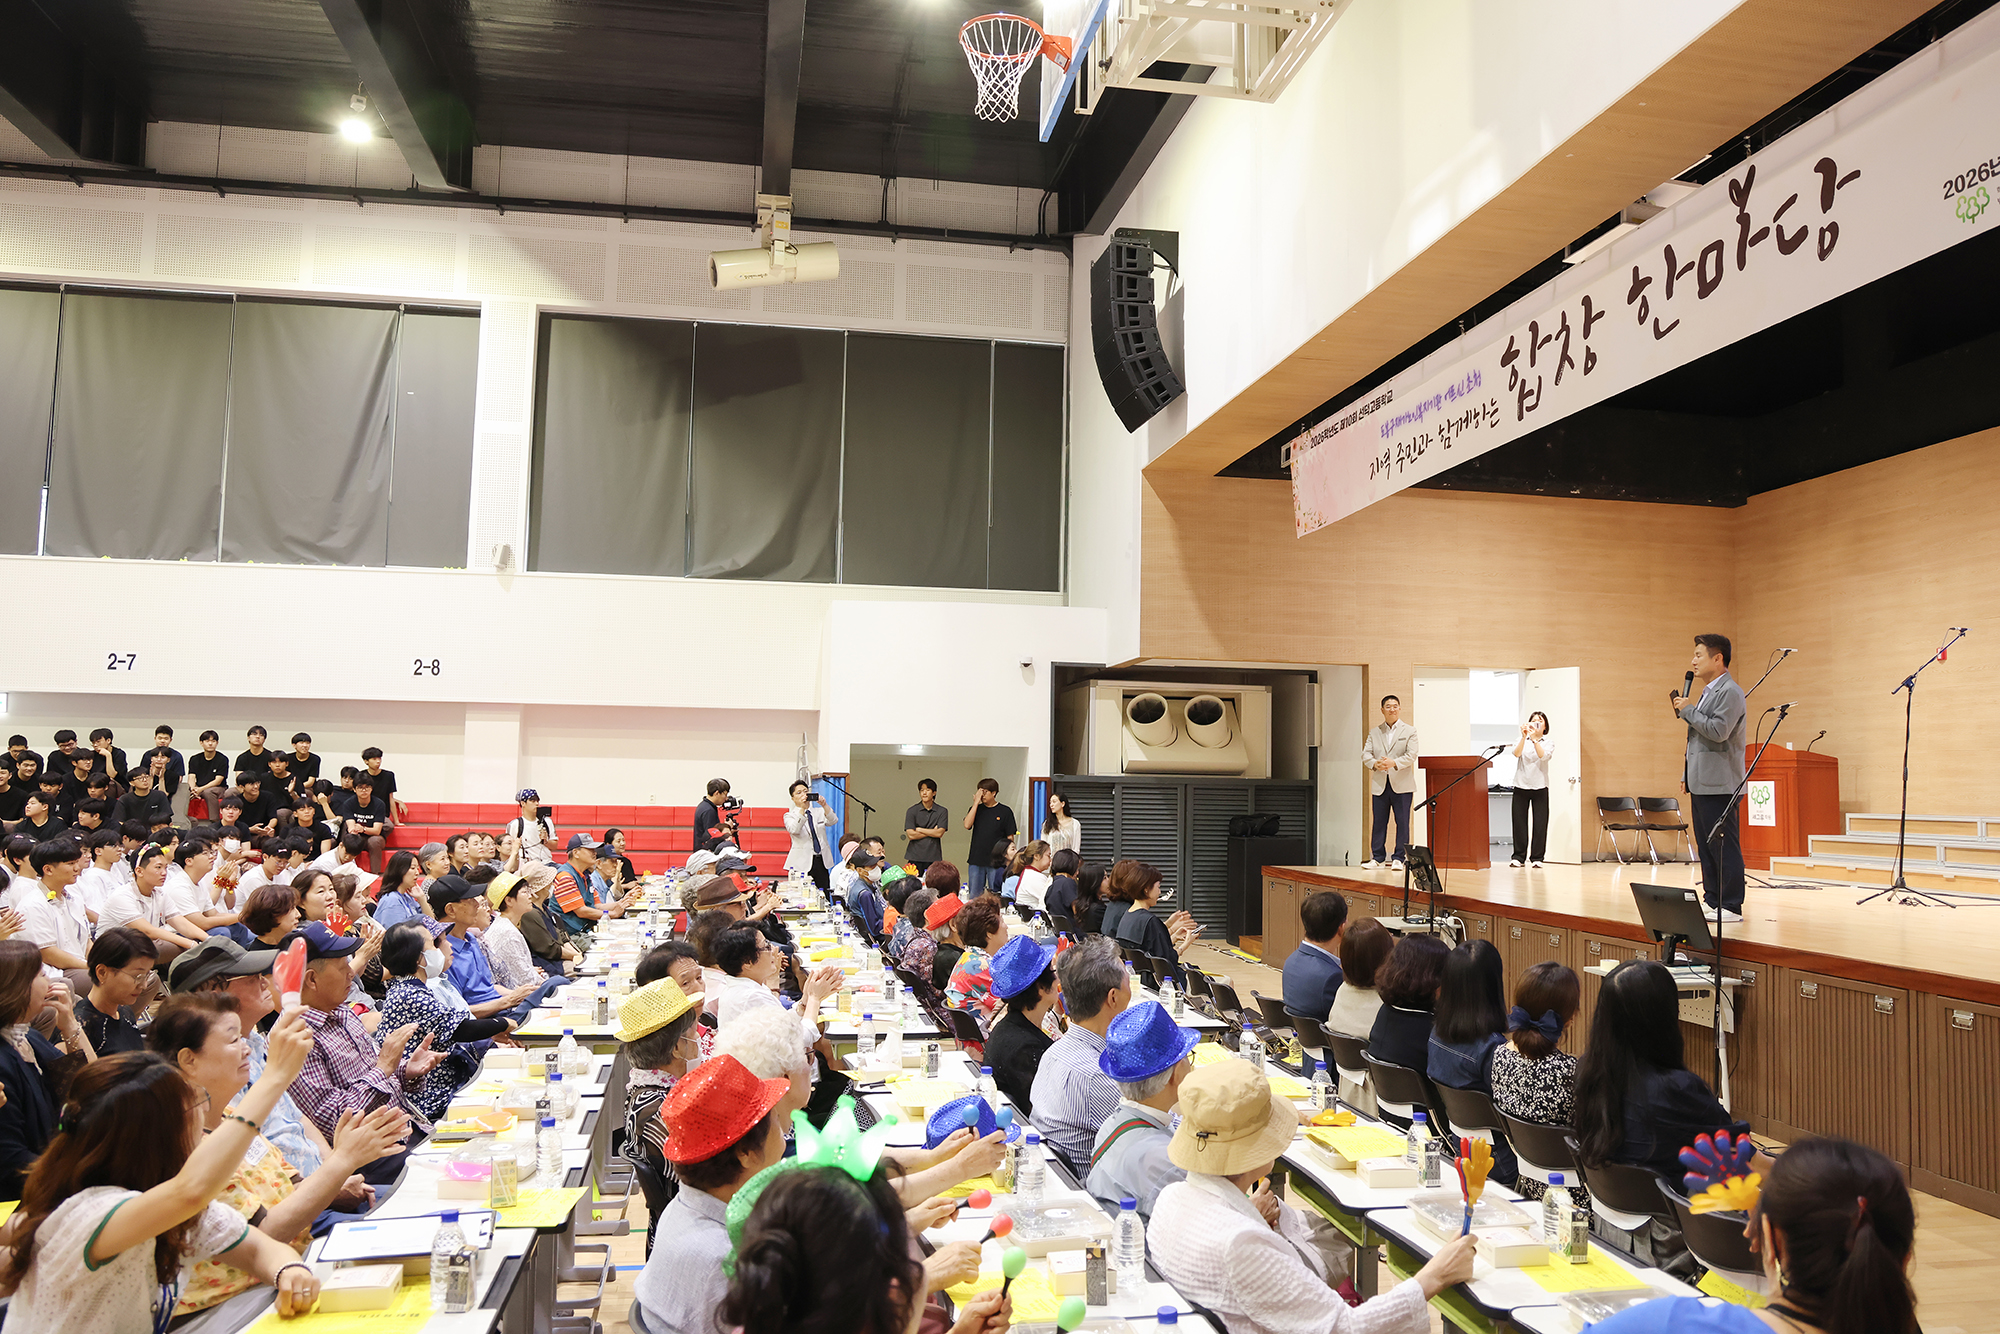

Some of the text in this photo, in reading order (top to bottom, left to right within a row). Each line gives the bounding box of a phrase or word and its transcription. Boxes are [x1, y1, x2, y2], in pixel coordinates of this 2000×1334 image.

[1500, 157, 1860, 421] 합창 한마당
[1340, 410, 1358, 431] 제10회
[1358, 389, 1393, 421] 선덕고등학교
[1369, 397, 1500, 480] 지역 주민과 함께하는
[107, 652, 137, 671] 2-7
[413, 658, 441, 676] 2-8
